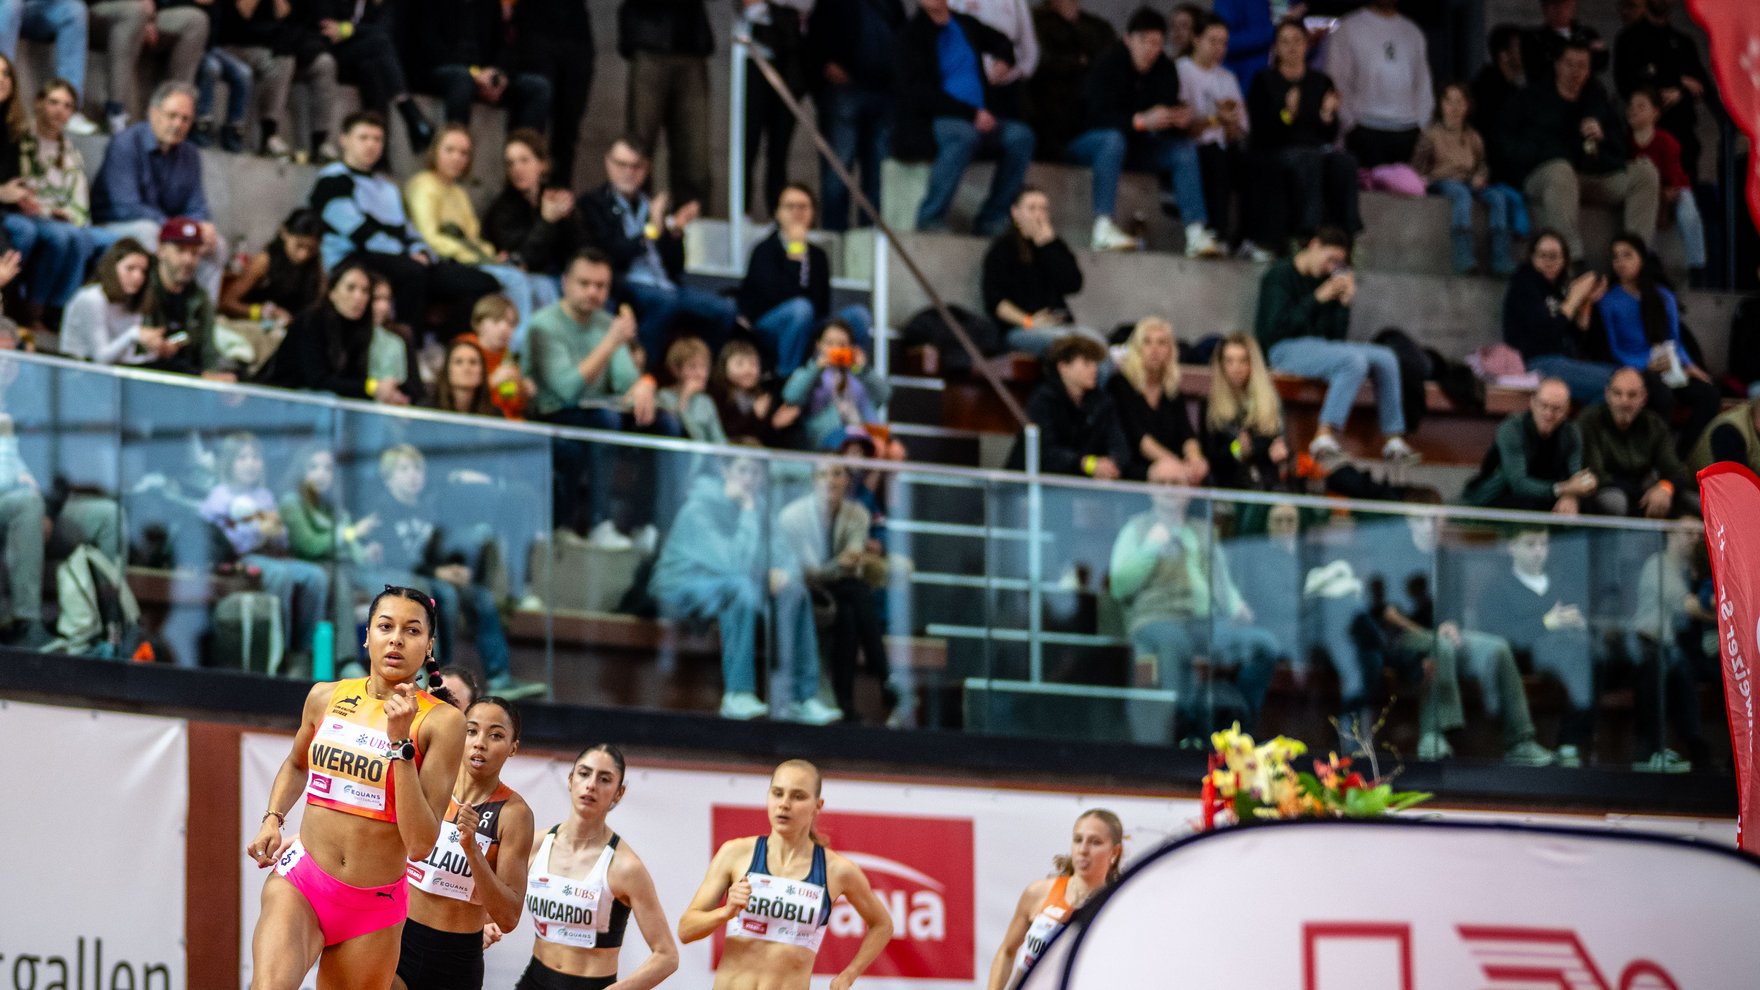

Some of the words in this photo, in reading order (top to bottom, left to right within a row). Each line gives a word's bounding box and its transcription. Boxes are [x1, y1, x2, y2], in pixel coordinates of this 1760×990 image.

[312, 743, 383, 783] WERRO
[351, 788, 381, 801] EQUANS
[422, 846, 473, 878] LAUD
[440, 881, 468, 892] EQUANS
[574, 887, 595, 900] UBS
[798, 887, 819, 900] UBS
[746, 895, 815, 925] GRÖBLI
[0, 936, 171, 990] gallen
